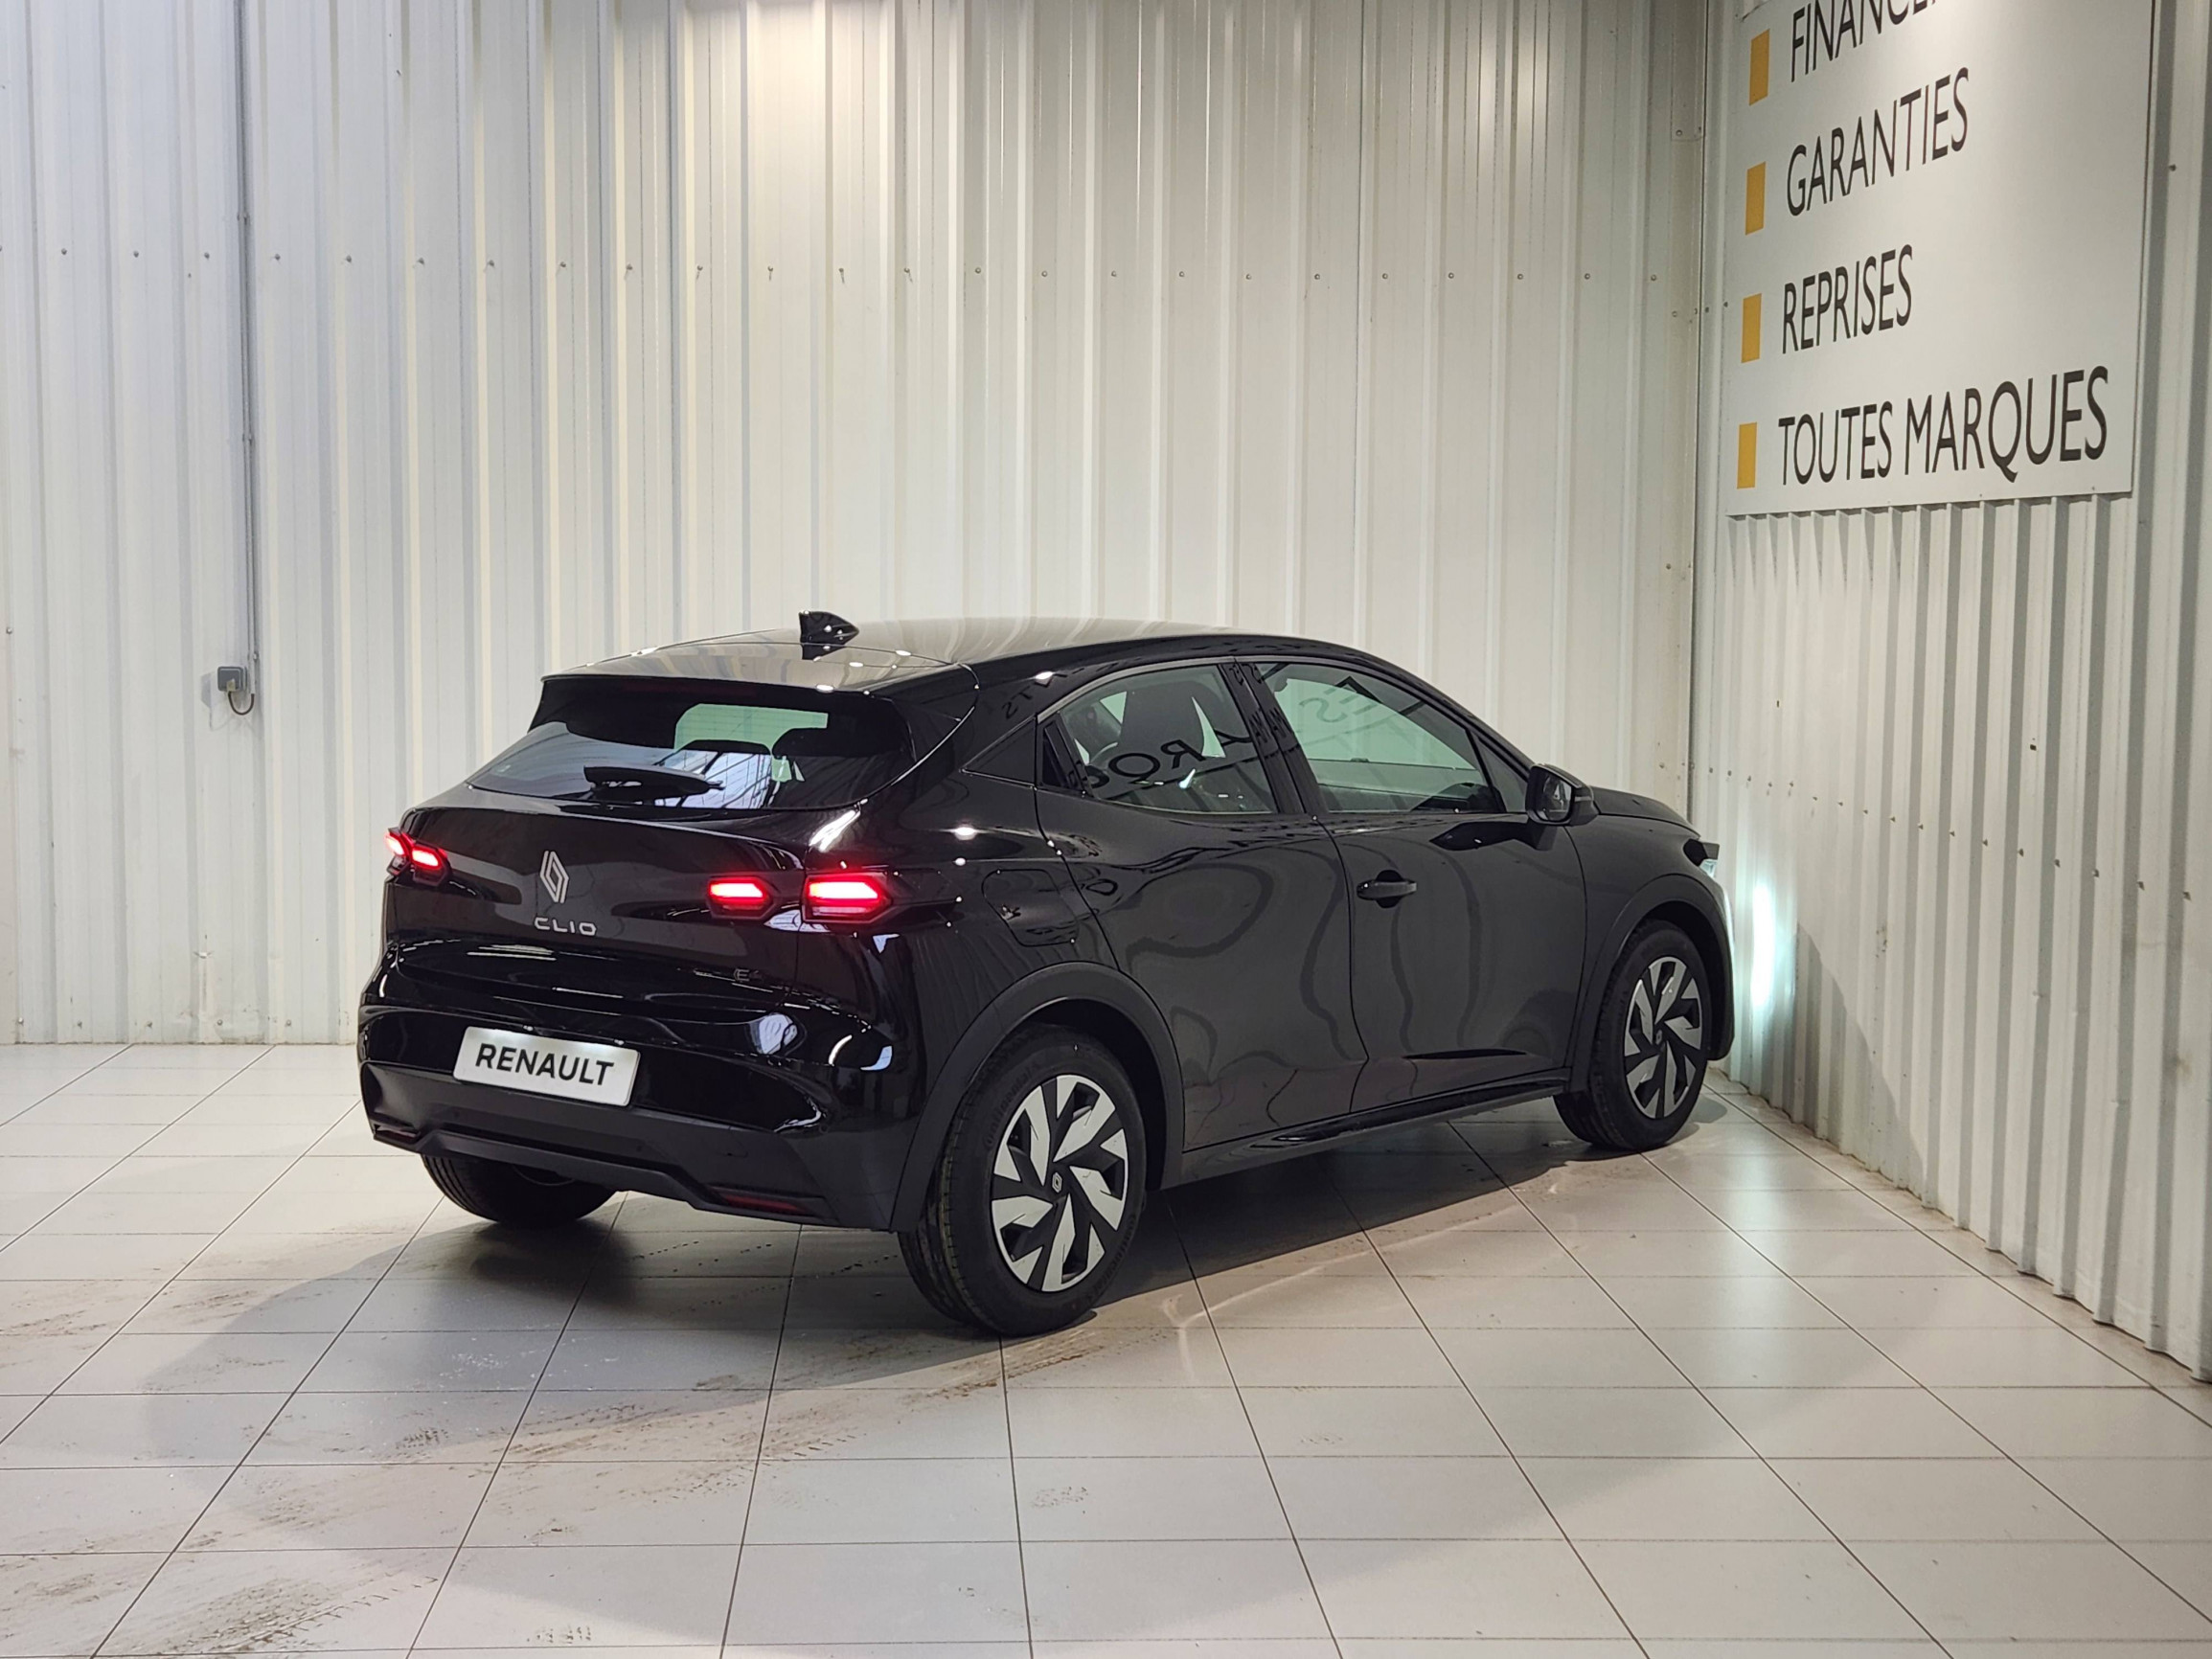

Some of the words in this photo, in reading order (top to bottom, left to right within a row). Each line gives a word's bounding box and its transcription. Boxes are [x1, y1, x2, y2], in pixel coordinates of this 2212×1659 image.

[1787, 67, 1970, 216] GARANTIES
[1783, 244, 1913, 354] REPRISES
[1778, 401, 1893, 486] TOUTES
[1904, 366, 2109, 483] MARQUES
[535, 917, 597, 936] CLIO
[475, 1043, 614, 1085] RENAULT
